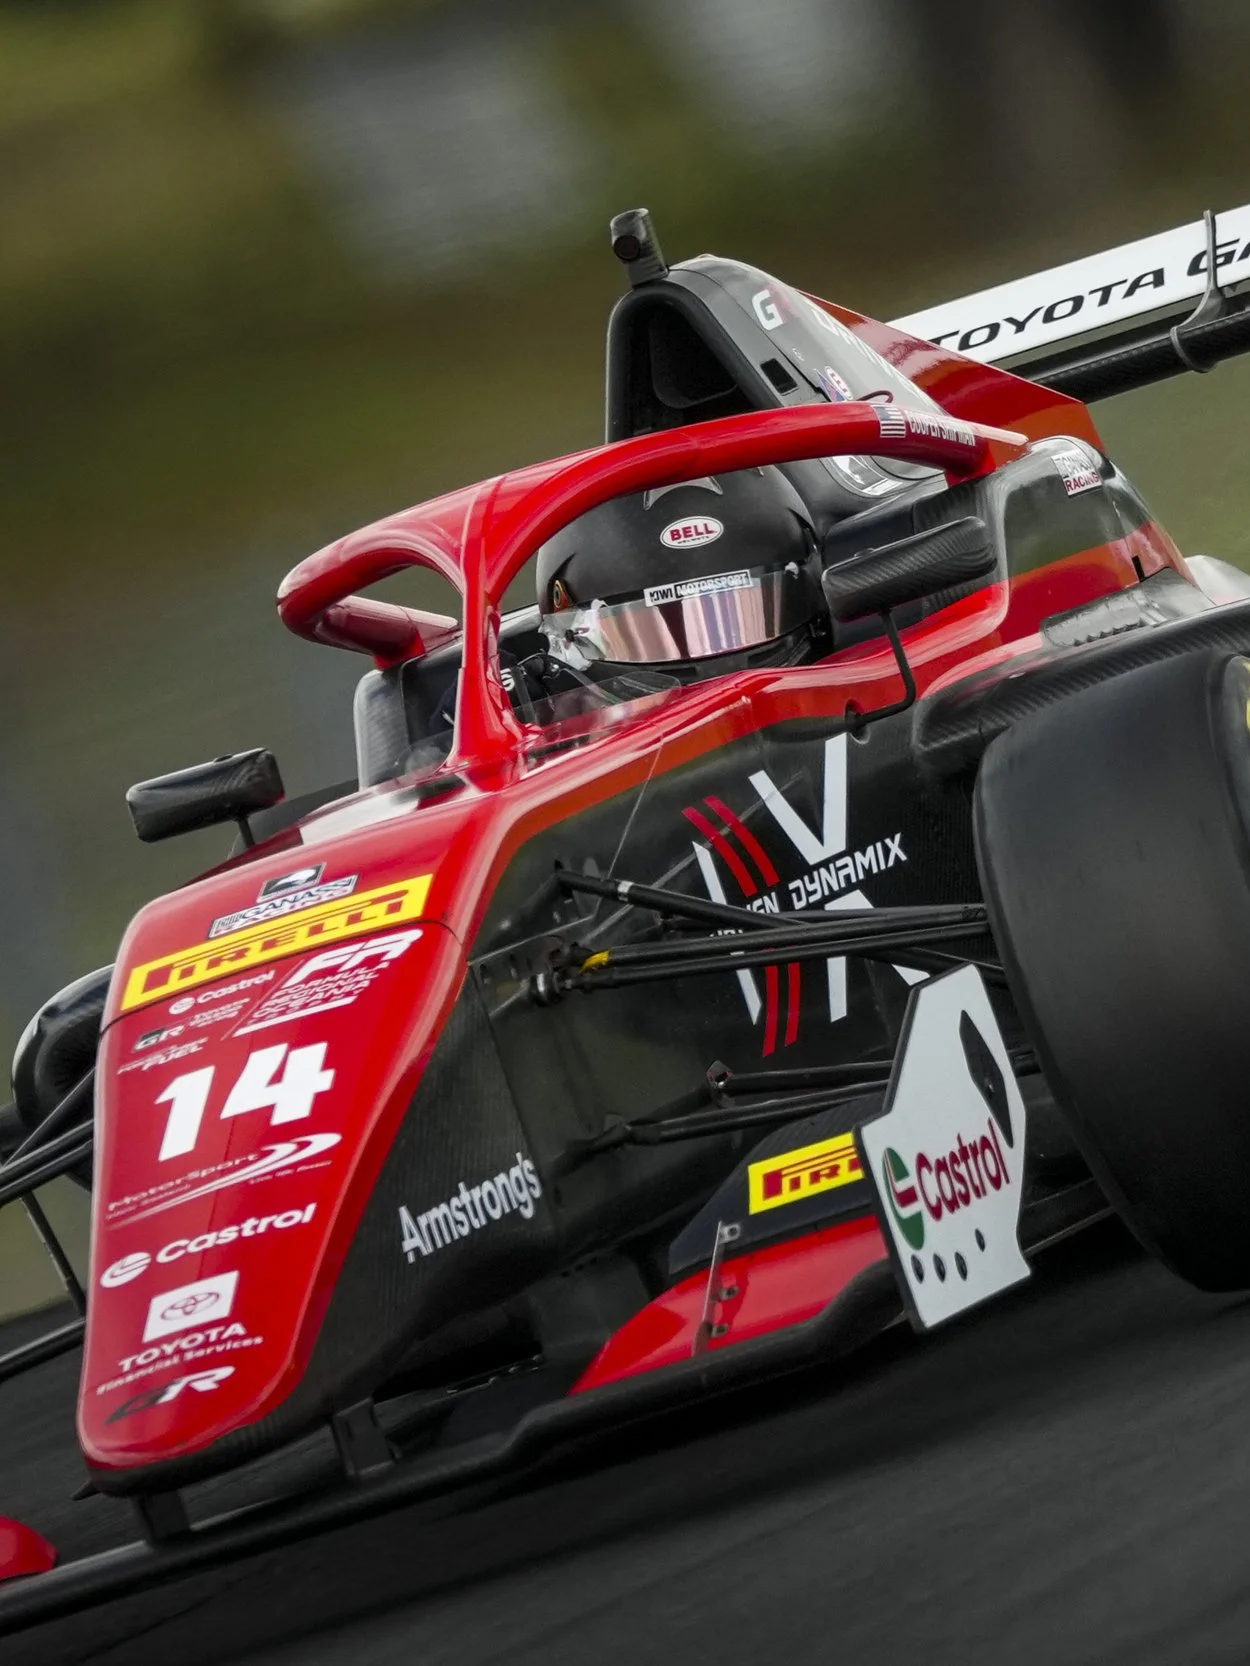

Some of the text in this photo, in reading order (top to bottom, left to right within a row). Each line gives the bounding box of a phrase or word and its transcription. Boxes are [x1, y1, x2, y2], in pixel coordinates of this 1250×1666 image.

[929, 268, 1164, 351] TOYOTA
[1065, 471, 1100, 493] RACING
[670, 523, 714, 542] BELL
[677, 574, 748, 597] MOTORSPORT
[789, 832, 908, 910] DYNAMIX
[141, 888, 409, 994] PIRELLI
[197, 969, 276, 1003] Castrol
[252, 980, 371, 1018] OCEANIA
[271, 961, 390, 999] FORMULA
[155, 1043, 336, 1162] 14
[914, 1116, 1011, 1221] Castrol
[156, 1202, 318, 1263] Castrol
[399, 1152, 542, 1264] Armstrong's
[97, 1336, 264, 1395] Financial Services
[118, 1322, 246, 1372] TOYOTA
